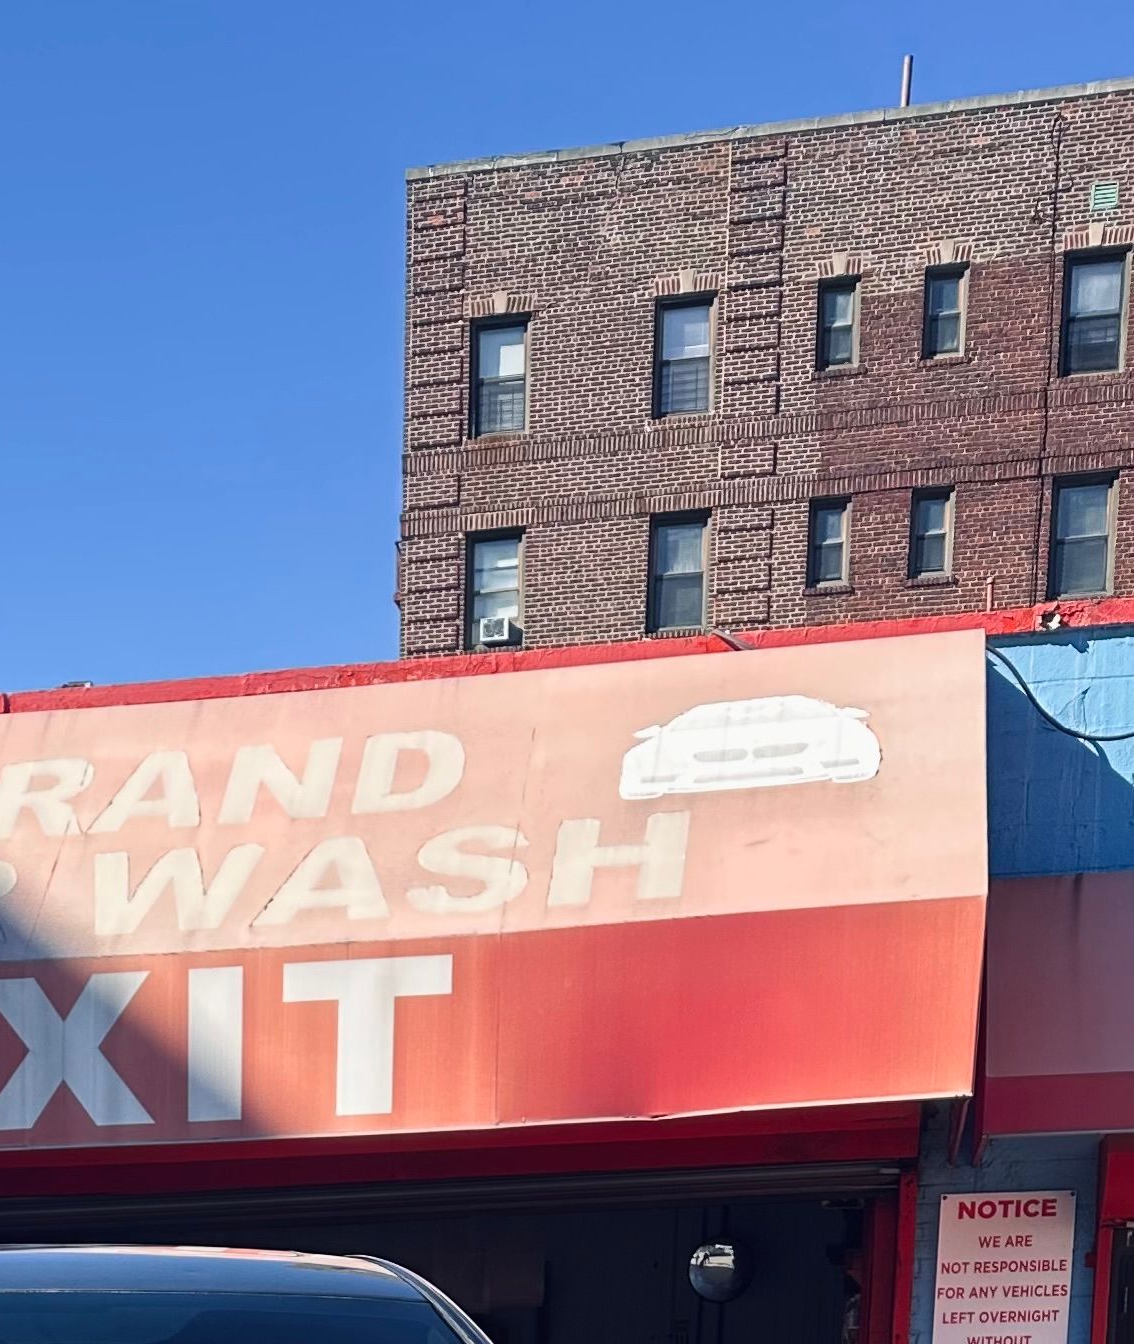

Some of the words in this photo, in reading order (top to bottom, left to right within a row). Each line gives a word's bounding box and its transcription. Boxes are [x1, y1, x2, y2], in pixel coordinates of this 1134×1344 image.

[94, 810, 690, 936] WASH
[957, 1198, 1058, 1220] NOTICE
[978, 1235, 1001, 1248] WE
[1004, 1234, 1033, 1248] ARE
[940, 1261, 970, 1275] NOT
[973, 1259, 1068, 1274] RESPONSIBLE
[937, 1287, 965, 1300] FOR
[968, 1286, 998, 1299] ANY
[1002, 1284, 1068, 1298] VEHICLES
[942, 1311, 975, 1324] LEFT
[979, 1309, 1060, 1323] OVERNIGHT
